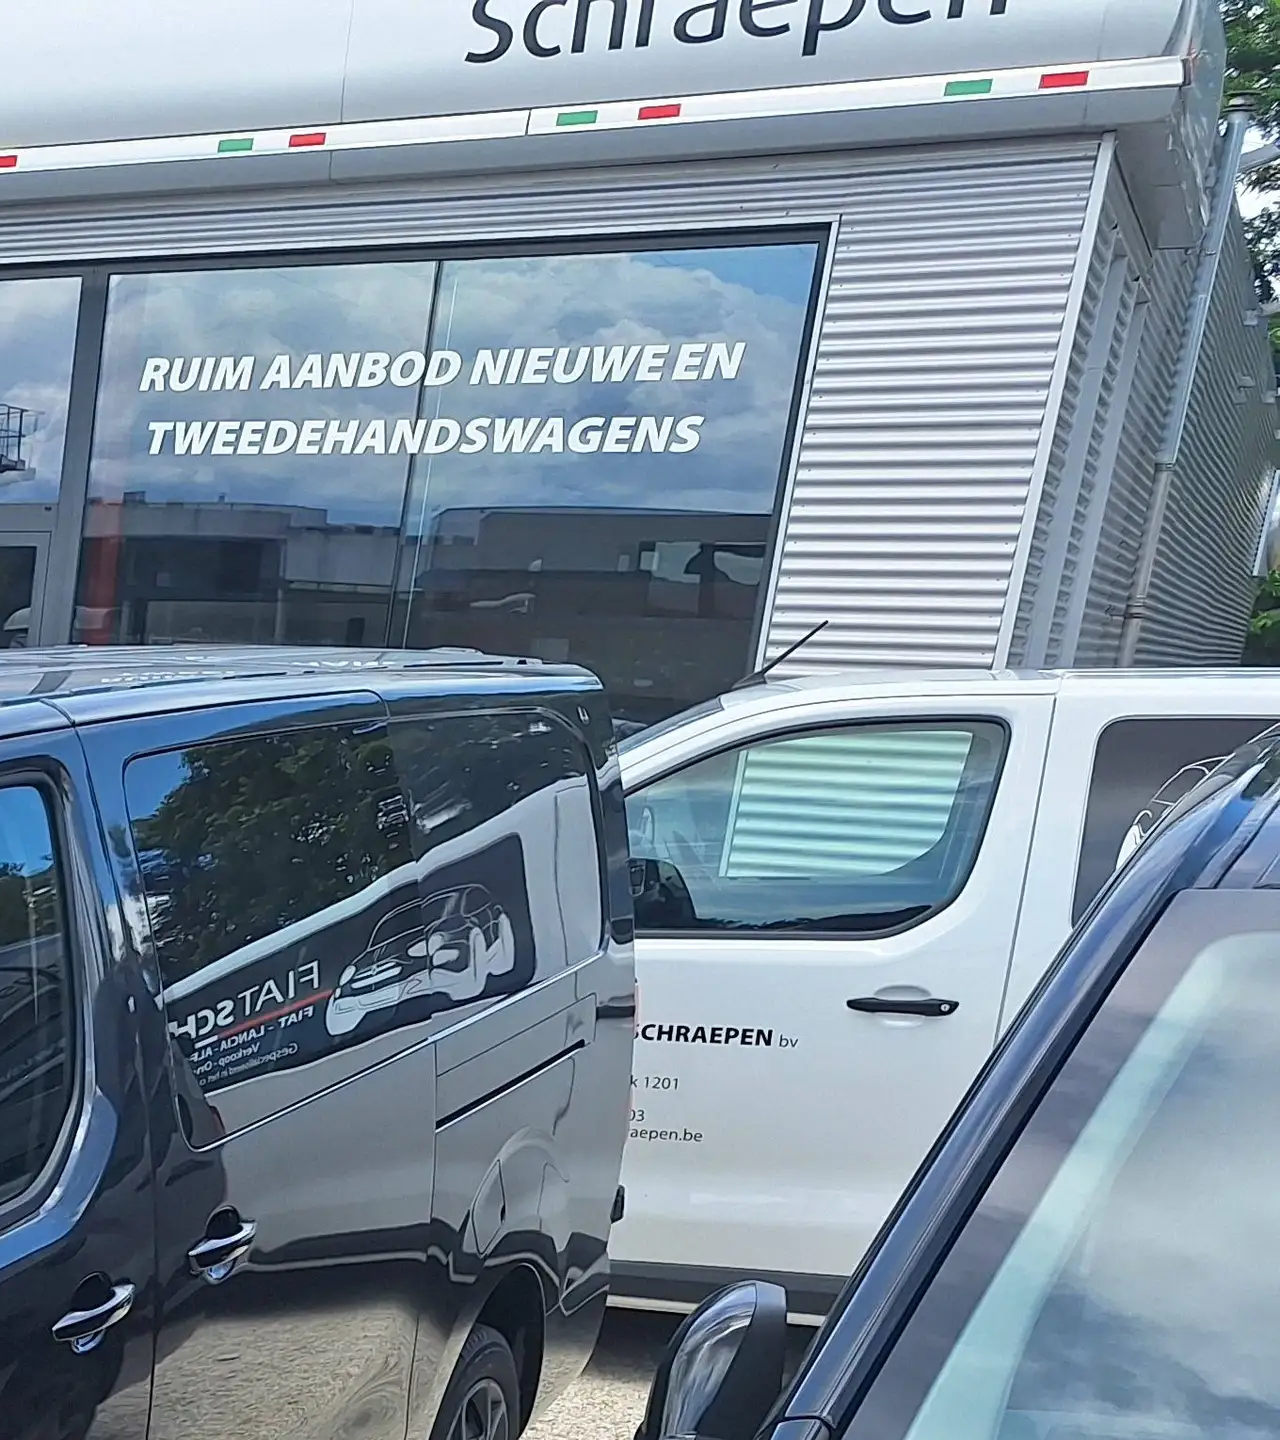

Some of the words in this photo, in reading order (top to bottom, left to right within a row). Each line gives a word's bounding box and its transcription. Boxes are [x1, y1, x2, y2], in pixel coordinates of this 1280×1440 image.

[139, 354, 258, 392] RUIM
[259, 350, 461, 390] AANBOD
[470, 345, 671, 386] NIEUWE
[671, 342, 747, 380] EN
[146, 414, 706, 455] TWEEDEHANDSWAGENS
[779, 1034, 799, 1048] bv
[644, 1076, 679, 1090] 1201
[629, 1128, 703, 1142] aepen.be
